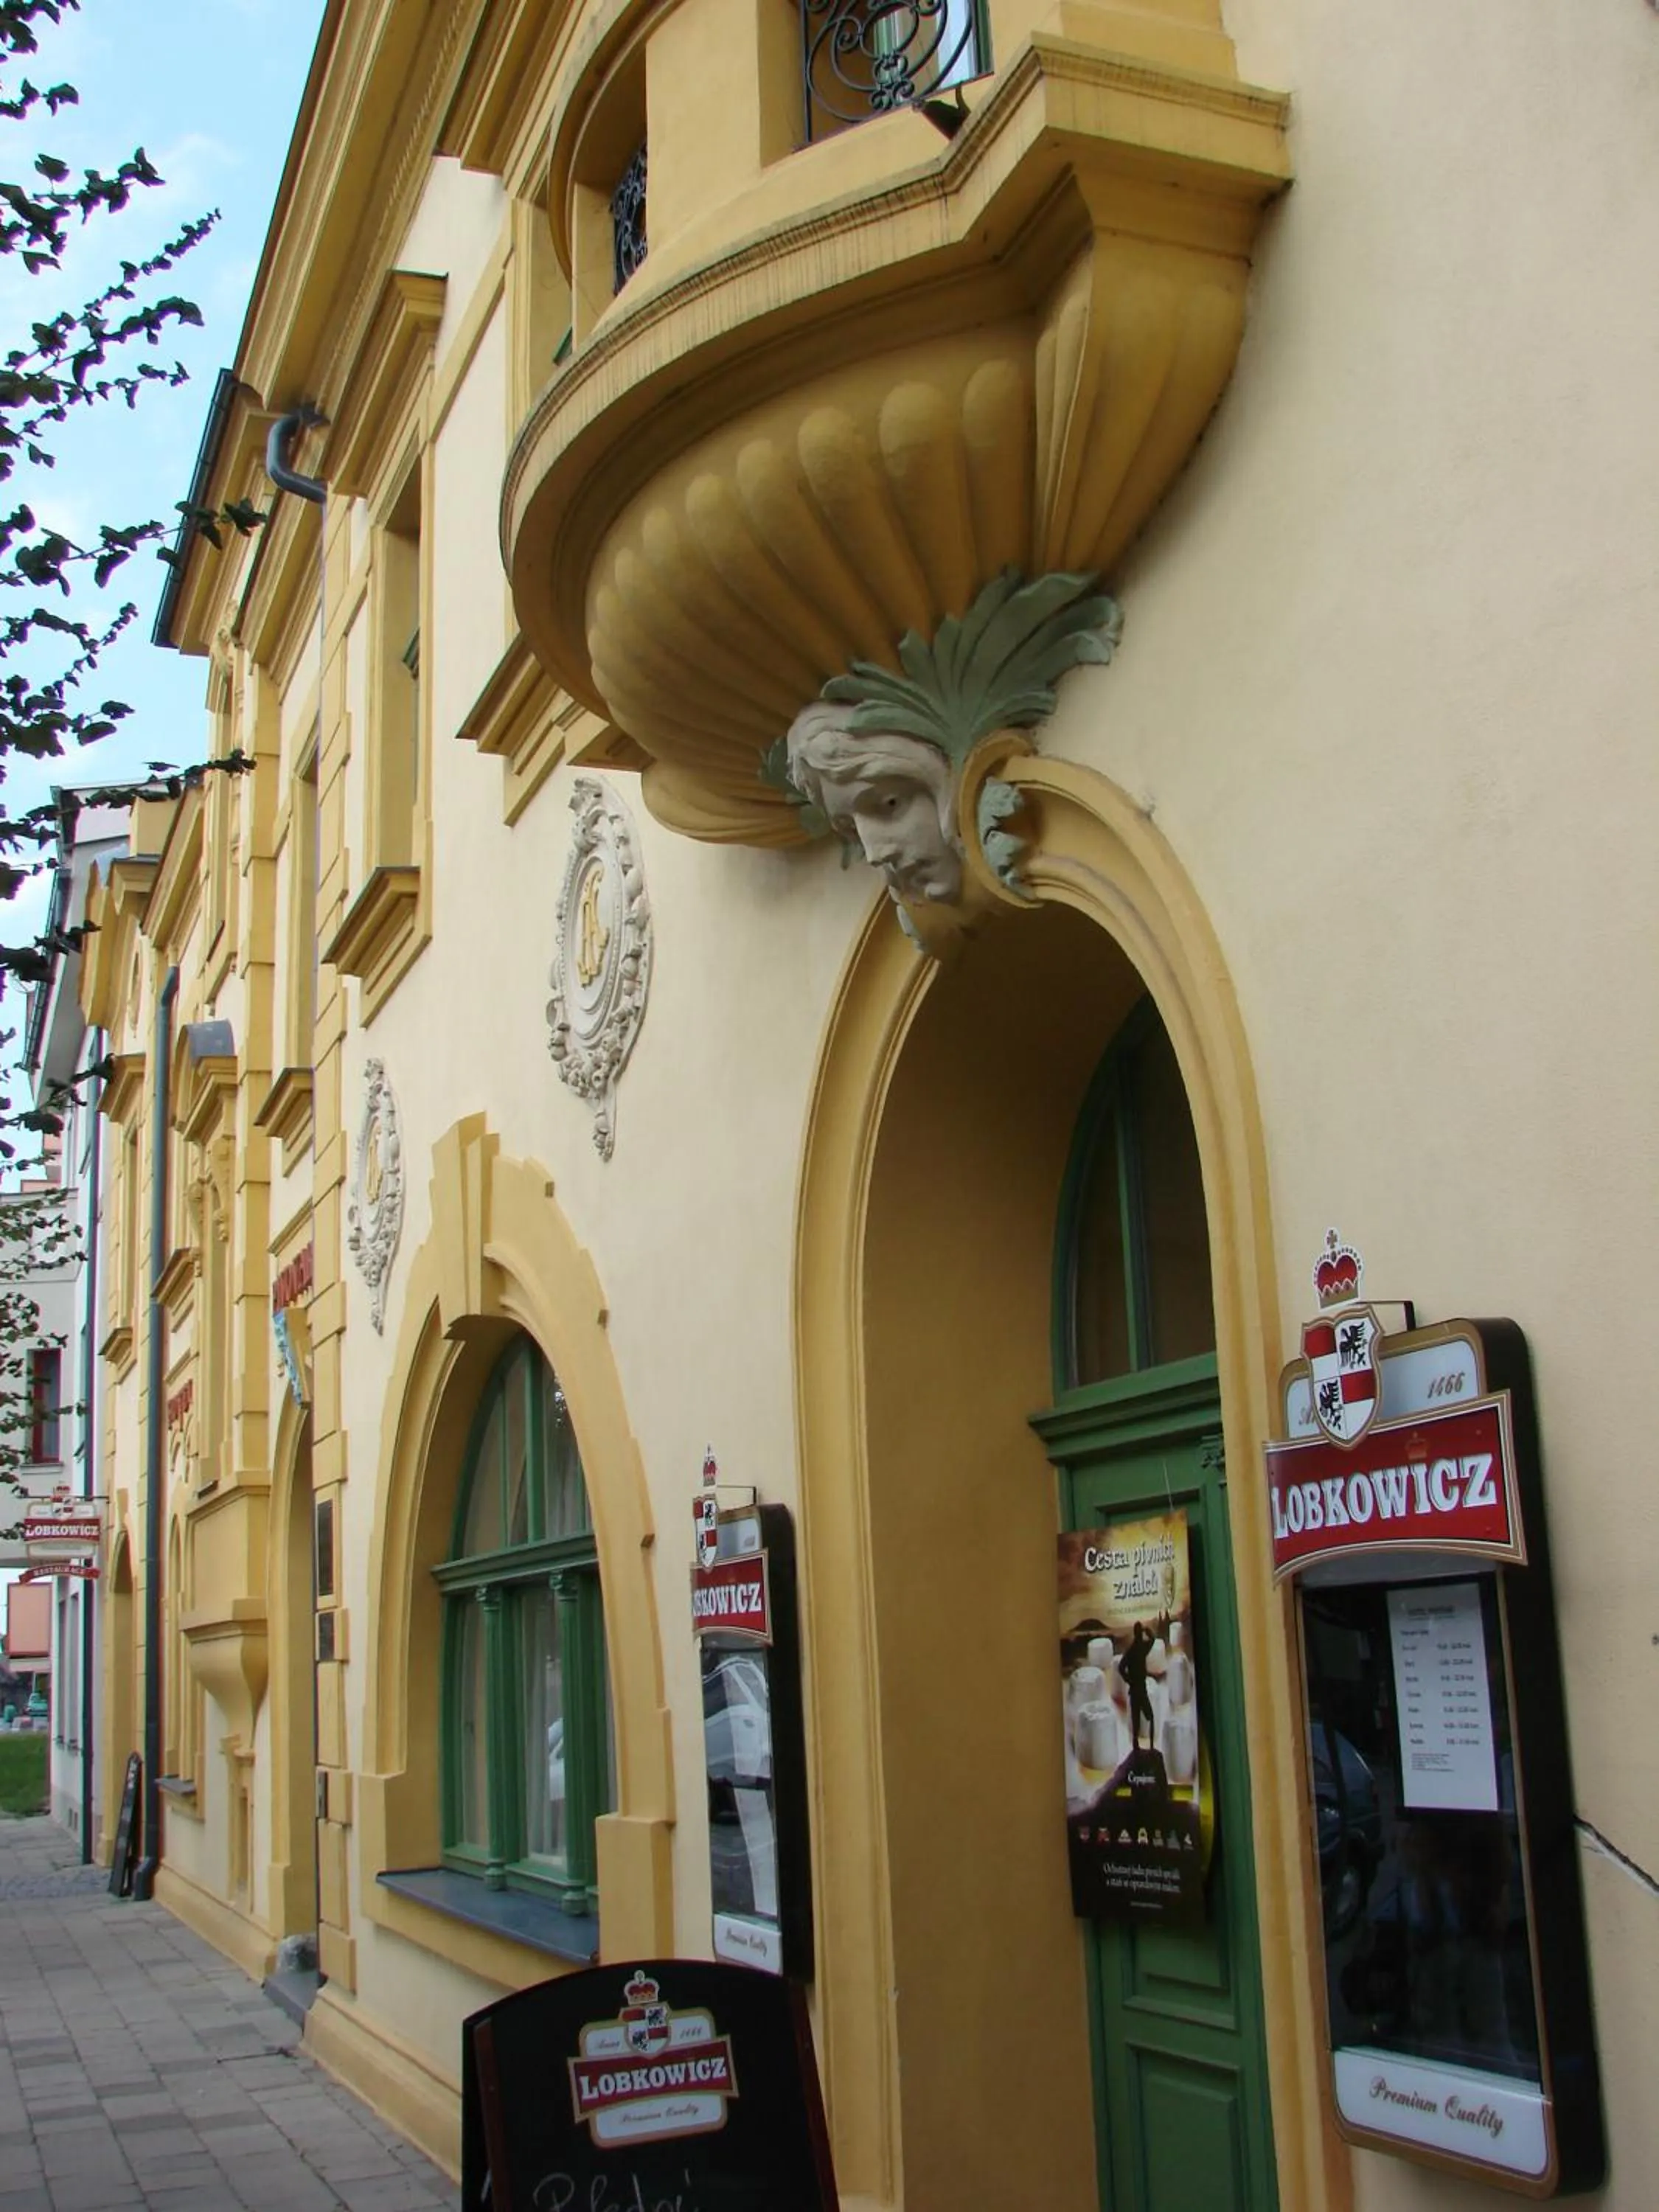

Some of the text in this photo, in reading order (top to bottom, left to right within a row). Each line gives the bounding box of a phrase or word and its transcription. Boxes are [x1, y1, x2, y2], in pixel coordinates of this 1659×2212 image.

[1427, 1371, 1464, 1399] 1466
[1271, 1452, 1498, 1540] LOBKOWICZ
[25, 1523, 99, 1536] LOBKOWICZ
[579, 2056, 727, 2100] LOBKOWICZ
[1368, 2075, 1505, 2139] Premium Quality
